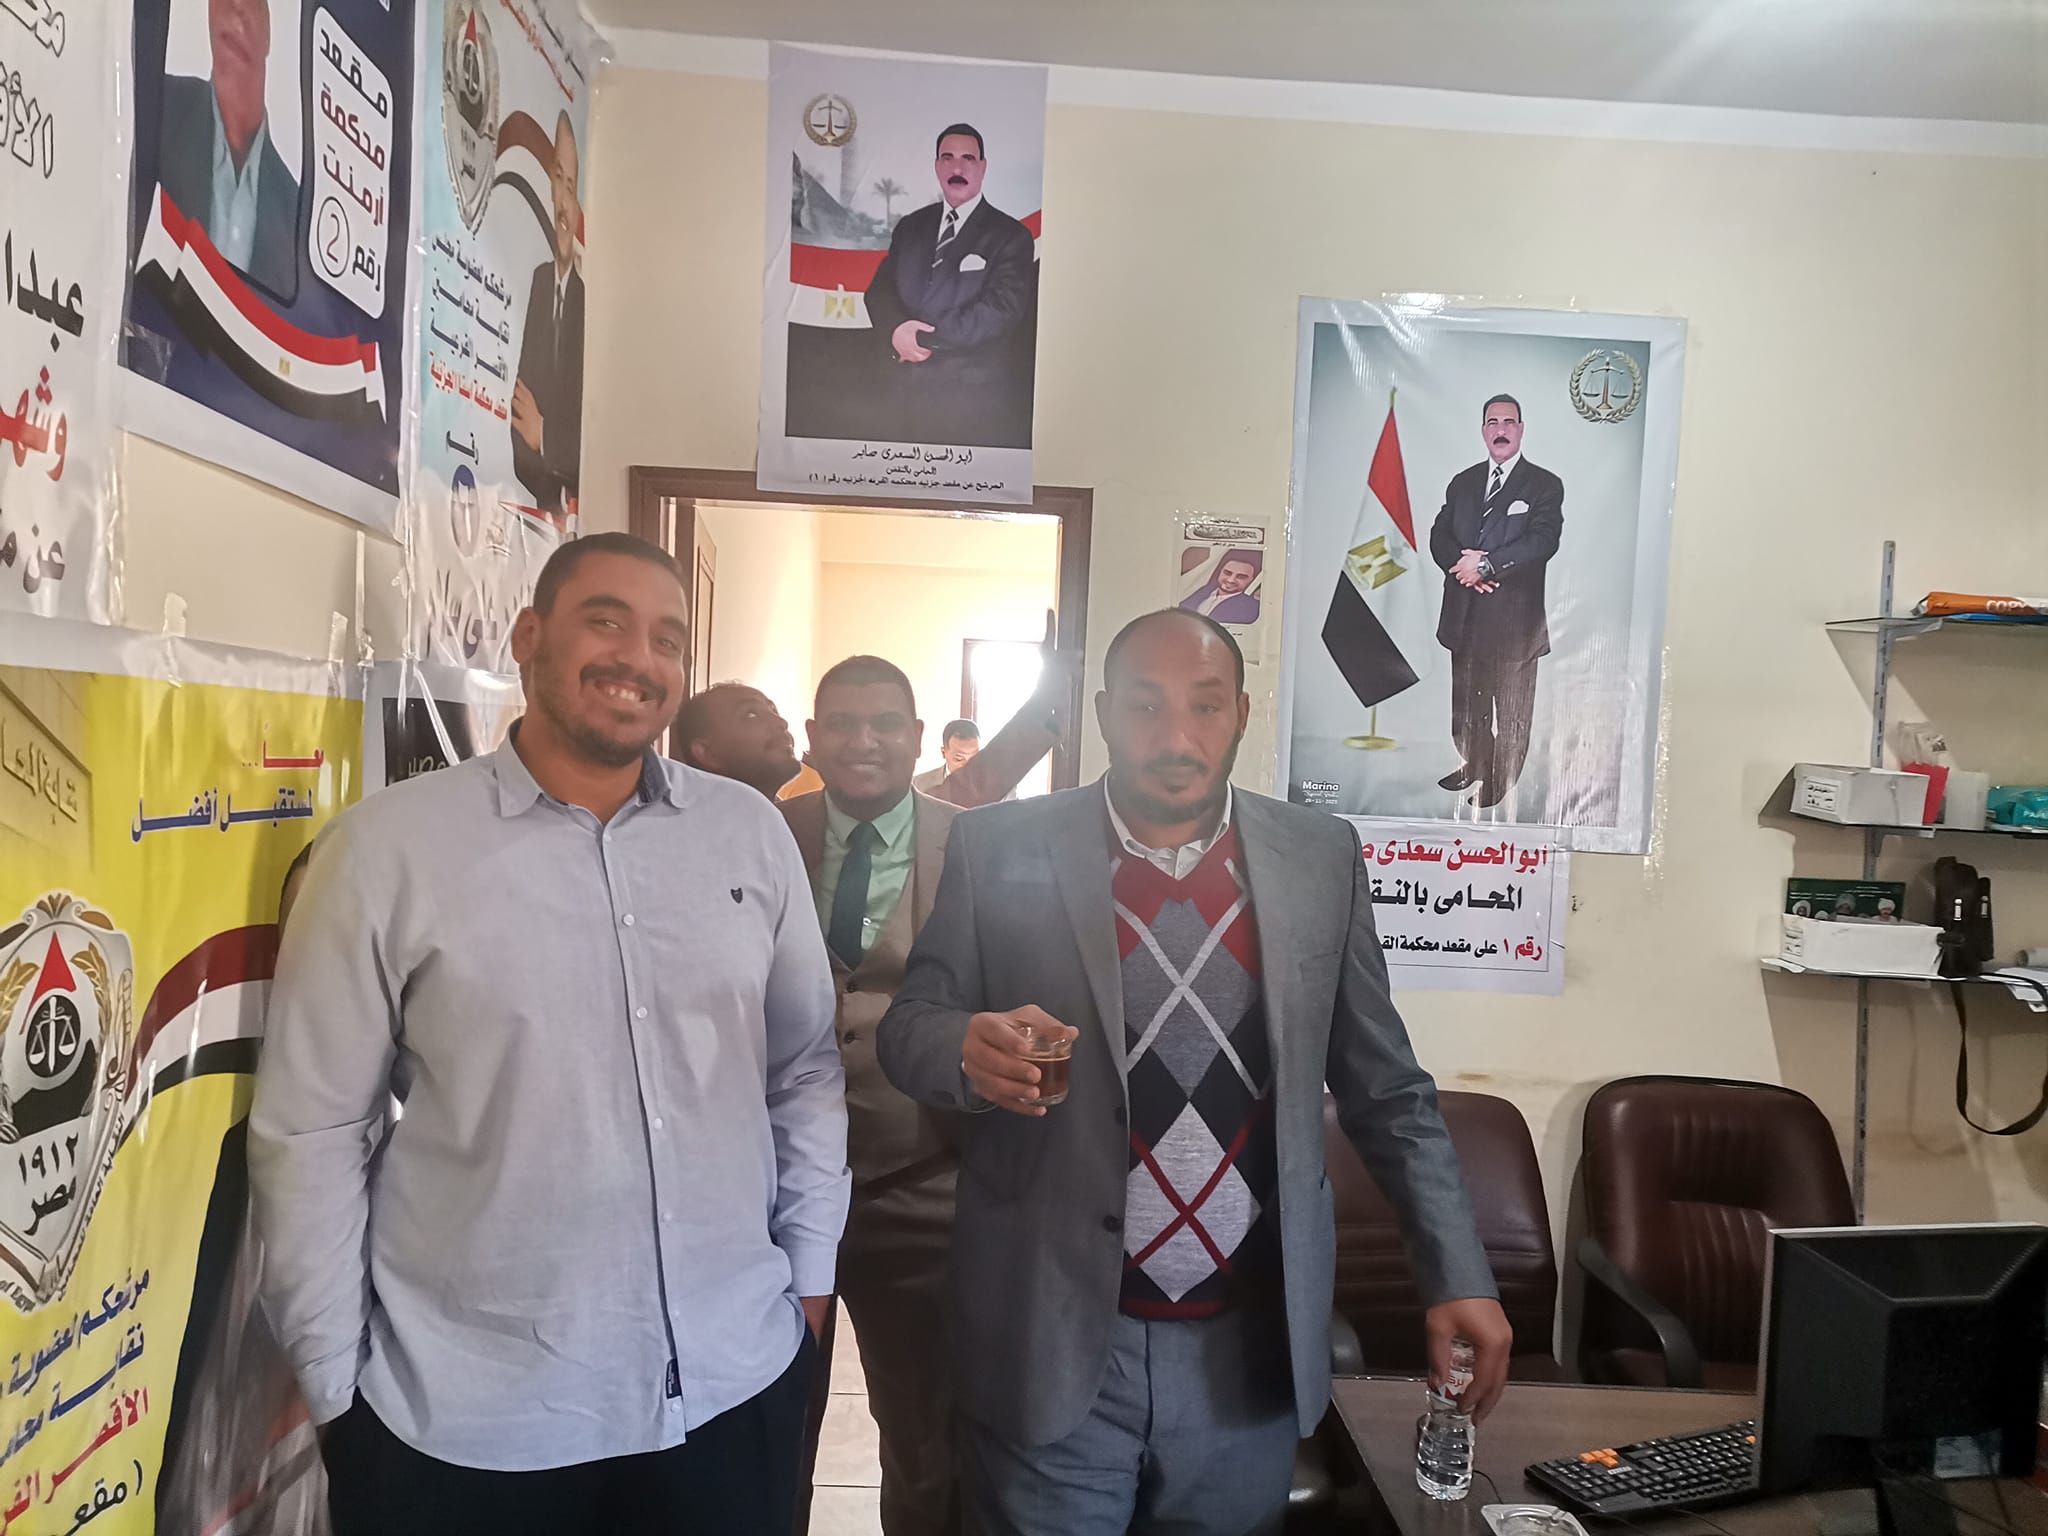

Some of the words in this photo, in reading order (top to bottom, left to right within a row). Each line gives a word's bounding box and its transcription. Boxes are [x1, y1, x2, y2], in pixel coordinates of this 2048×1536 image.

[320, 27, 388, 119] مقعد
[320, 82, 386, 171] محكمة
[322, 143, 385, 226] أرمنت
[352, 244, 383, 292] رقم
[1302, 780, 1340, 791] Marina
[1446, 838, 1514, 871] الحسن
[1371, 878, 1429, 914] بالنق
[1399, 935, 1440, 952] محكمة
[1441, 938, 1471, 953] مقعد
[1515, 936, 1543, 961] رقم
[18, 1132, 79, 1185] ١٩١٢
[24, 1175, 78, 1236] مصر
[49, 1322, 145, 1421] نقابة
